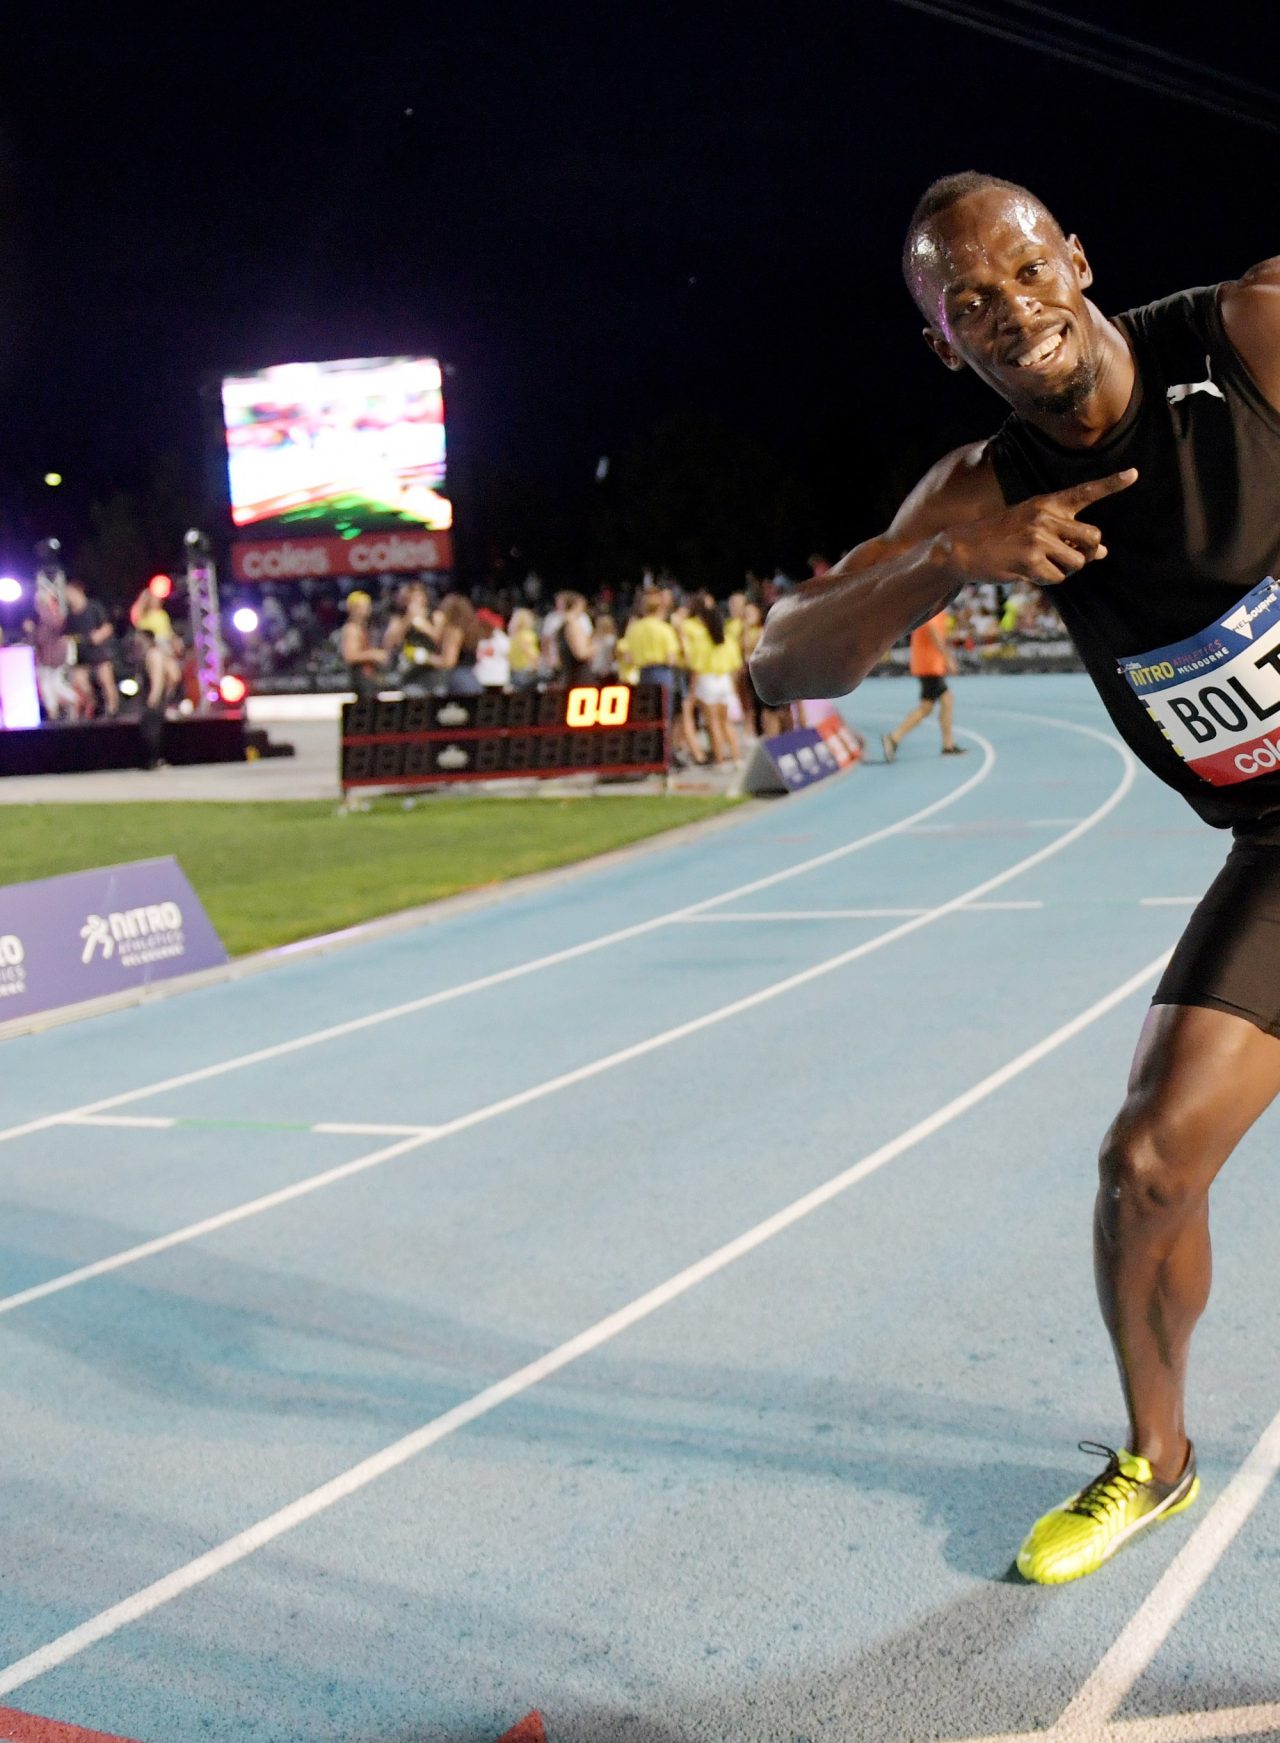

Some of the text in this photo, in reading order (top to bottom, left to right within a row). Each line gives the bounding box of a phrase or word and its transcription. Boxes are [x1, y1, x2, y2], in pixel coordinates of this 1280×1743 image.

[242, 535, 437, 578] coles coles
[1130, 661, 1175, 687] NITRO
[1177, 646, 1229, 674] MELBOURNE
[109, 901, 182, 942] NITRO
